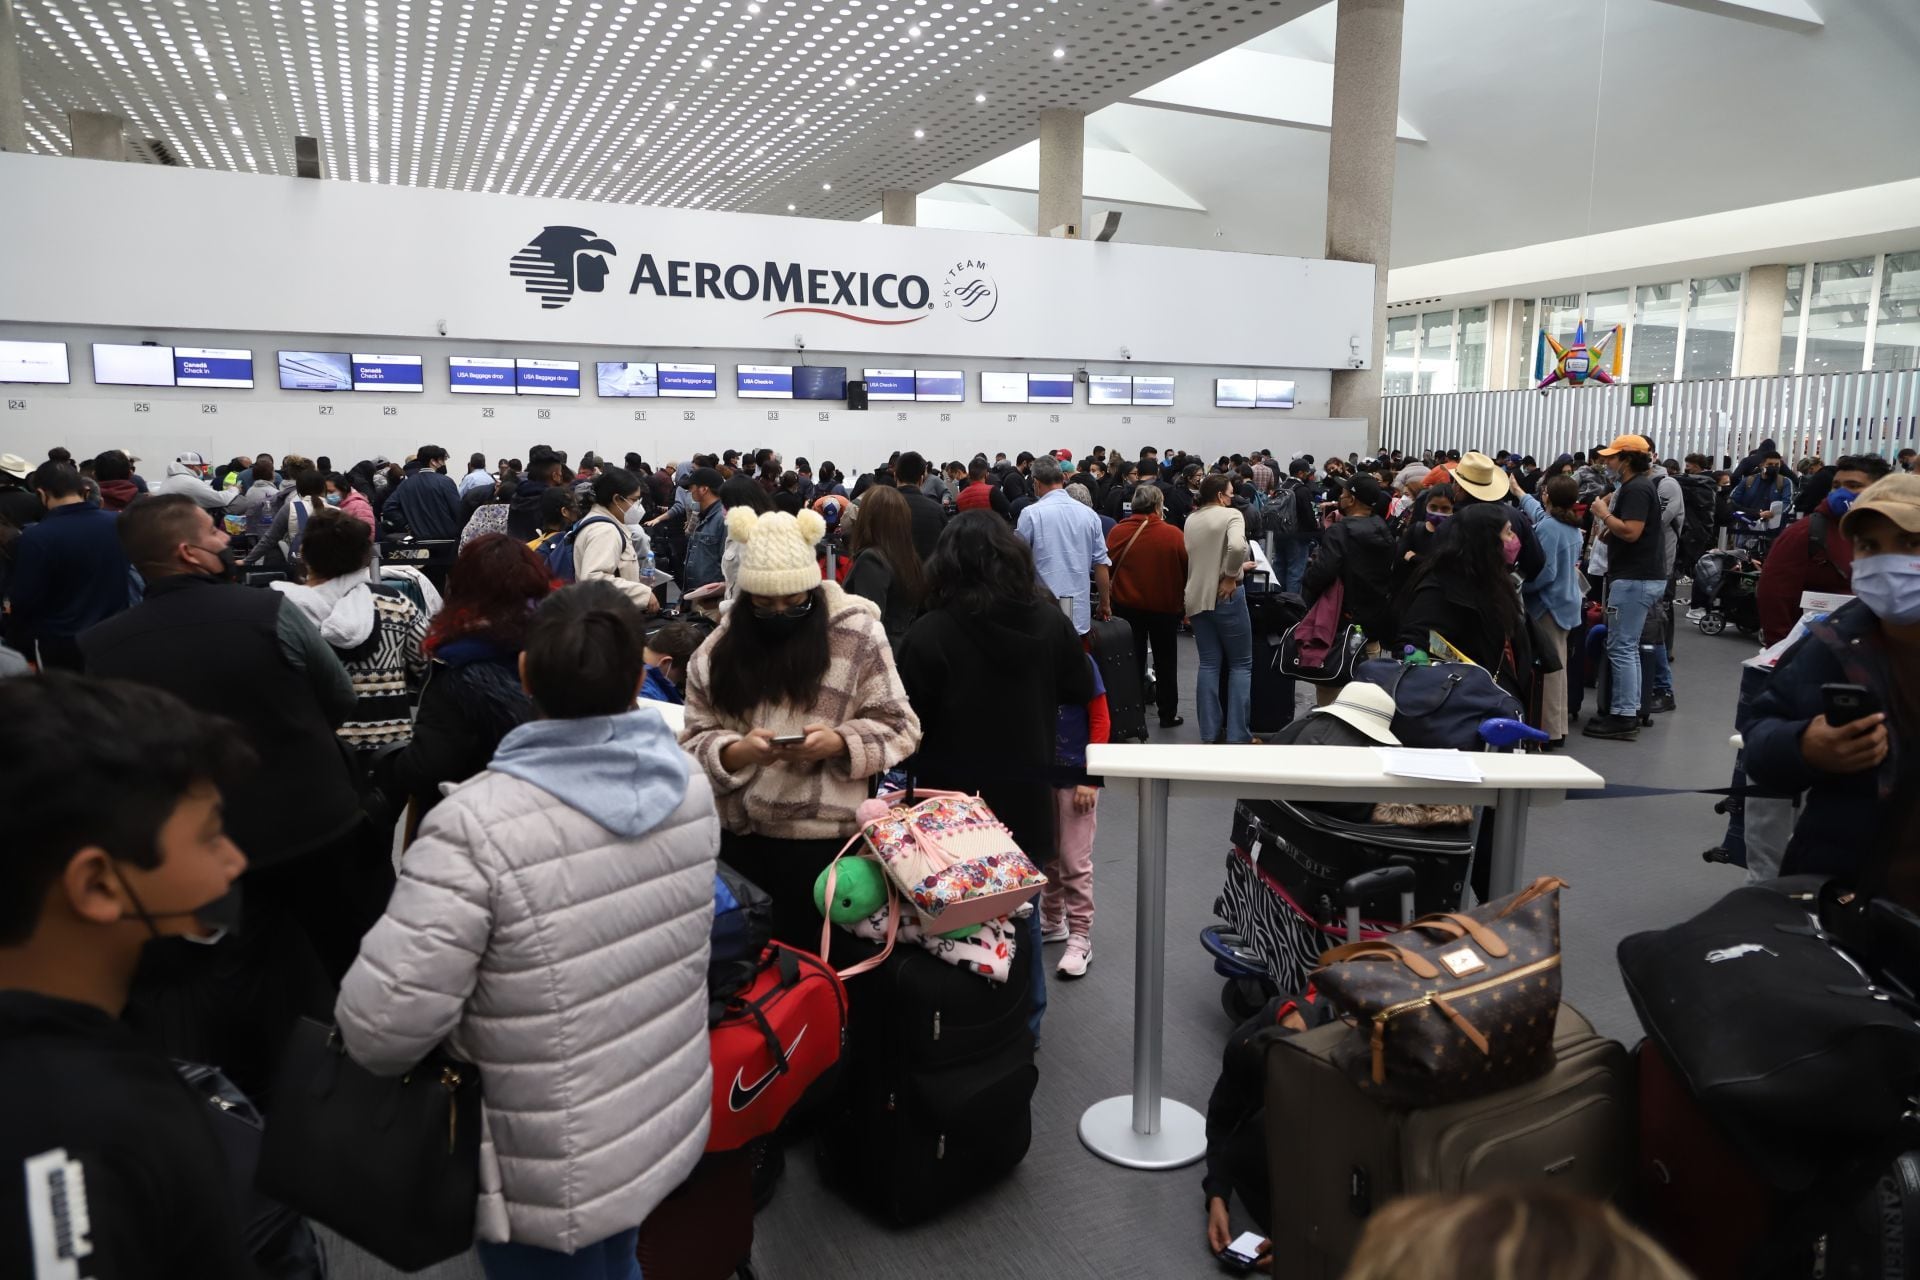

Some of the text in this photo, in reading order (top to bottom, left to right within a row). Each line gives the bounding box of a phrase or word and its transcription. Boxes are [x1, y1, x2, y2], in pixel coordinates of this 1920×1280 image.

[943, 259, 986, 309] SKYTEAM
[11, 401, 24, 409] 24
[136, 403, 149, 412] 25
[203, 404, 217, 413] 26
[321, 406, 332, 414] 27
[385, 407, 397, 415] 28
[483, 408, 494, 417] 29
[539, 409, 550, 418] 30
[636, 411, 646, 420] 31
[685, 411, 695, 420] 32
[769, 411, 779, 420] 33
[820, 412, 829, 420] 34
